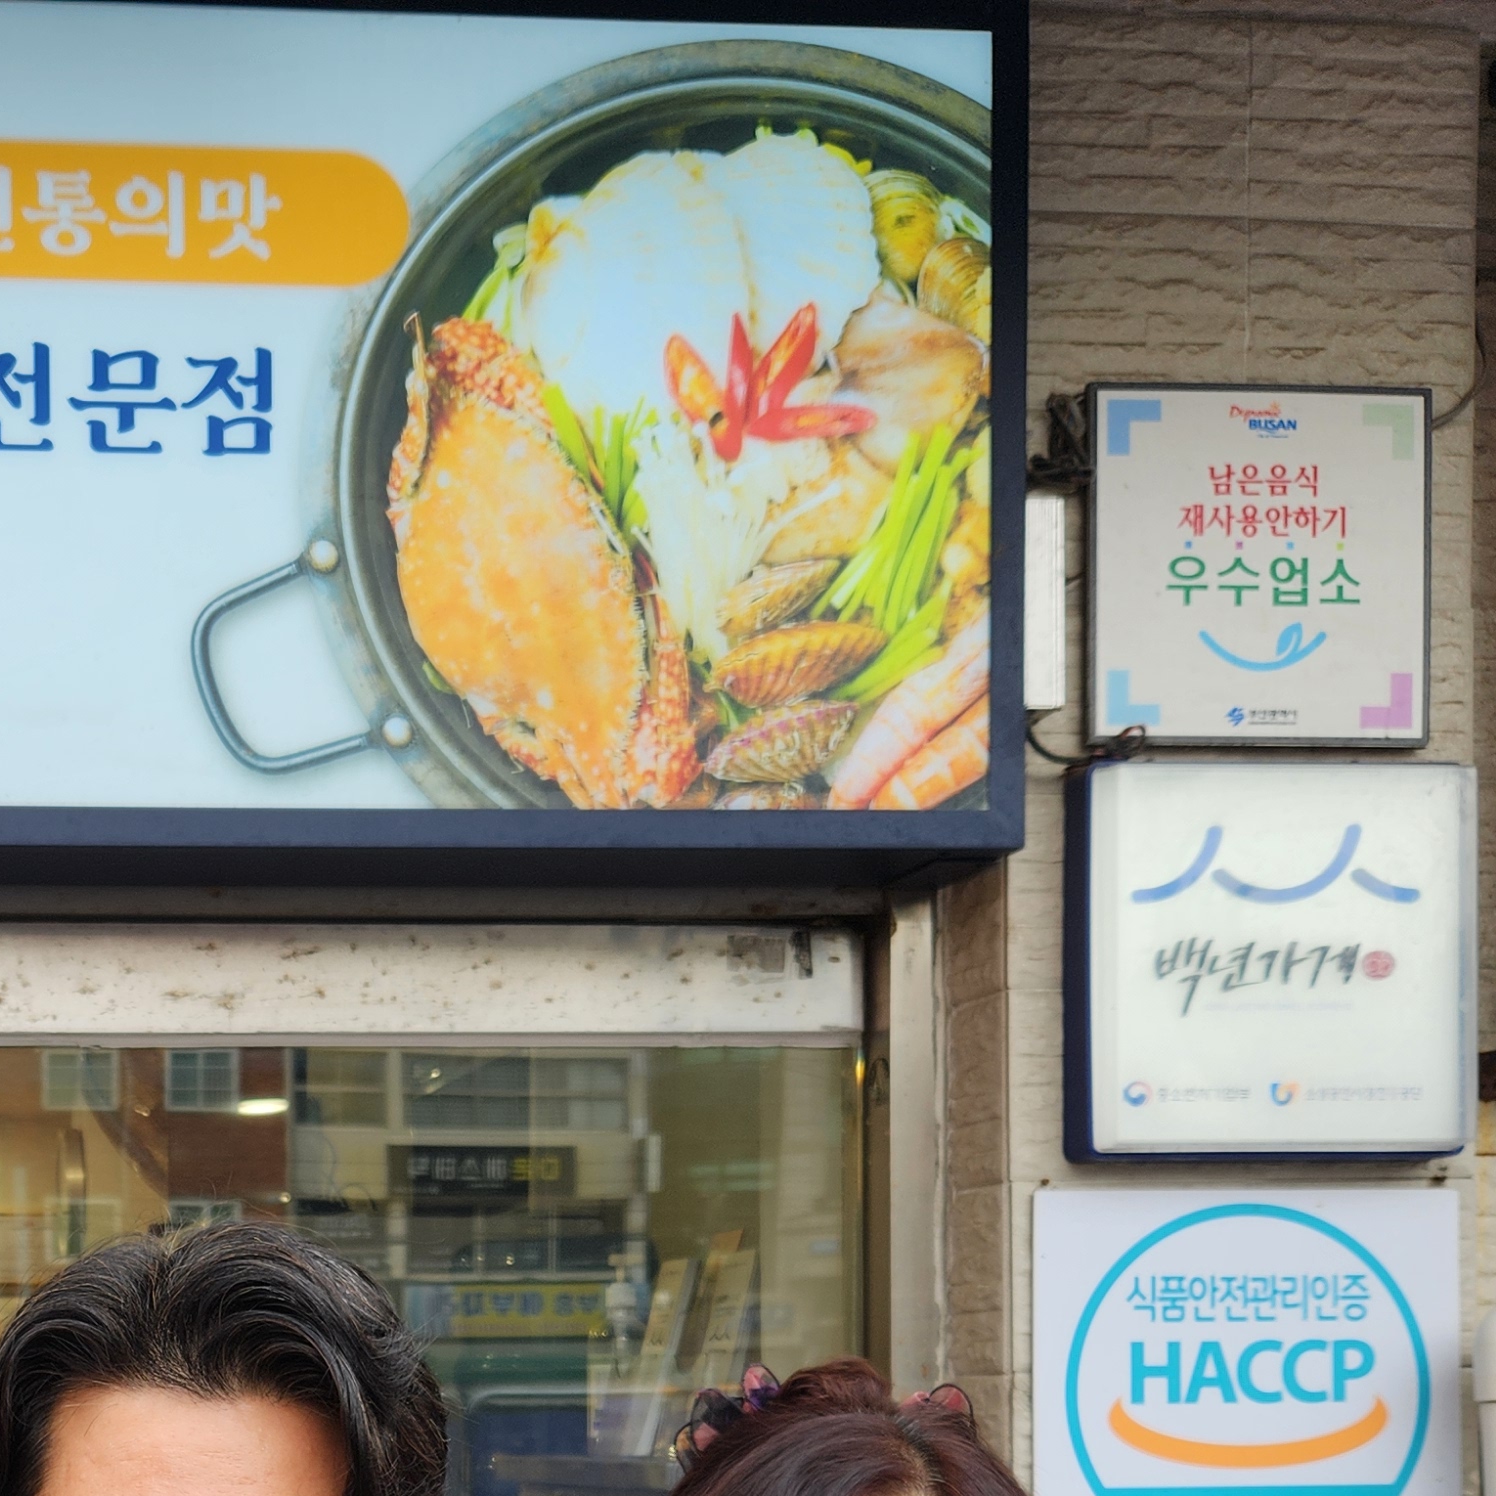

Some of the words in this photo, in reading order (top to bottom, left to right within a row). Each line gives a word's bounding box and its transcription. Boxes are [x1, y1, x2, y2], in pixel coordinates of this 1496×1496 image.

[1248, 418, 1297, 431] BUSAN
[1208, 464, 1319, 497] 남은음식
[1177, 504, 1347, 538] 재사용안하기
[1166, 556, 1360, 606] 우수업소
[1153, 937, 1361, 1017] 백년가게
[1126, 1274, 1371, 1323] 식품안전관리인증
[1130, 1339, 1376, 1405] HACCP
